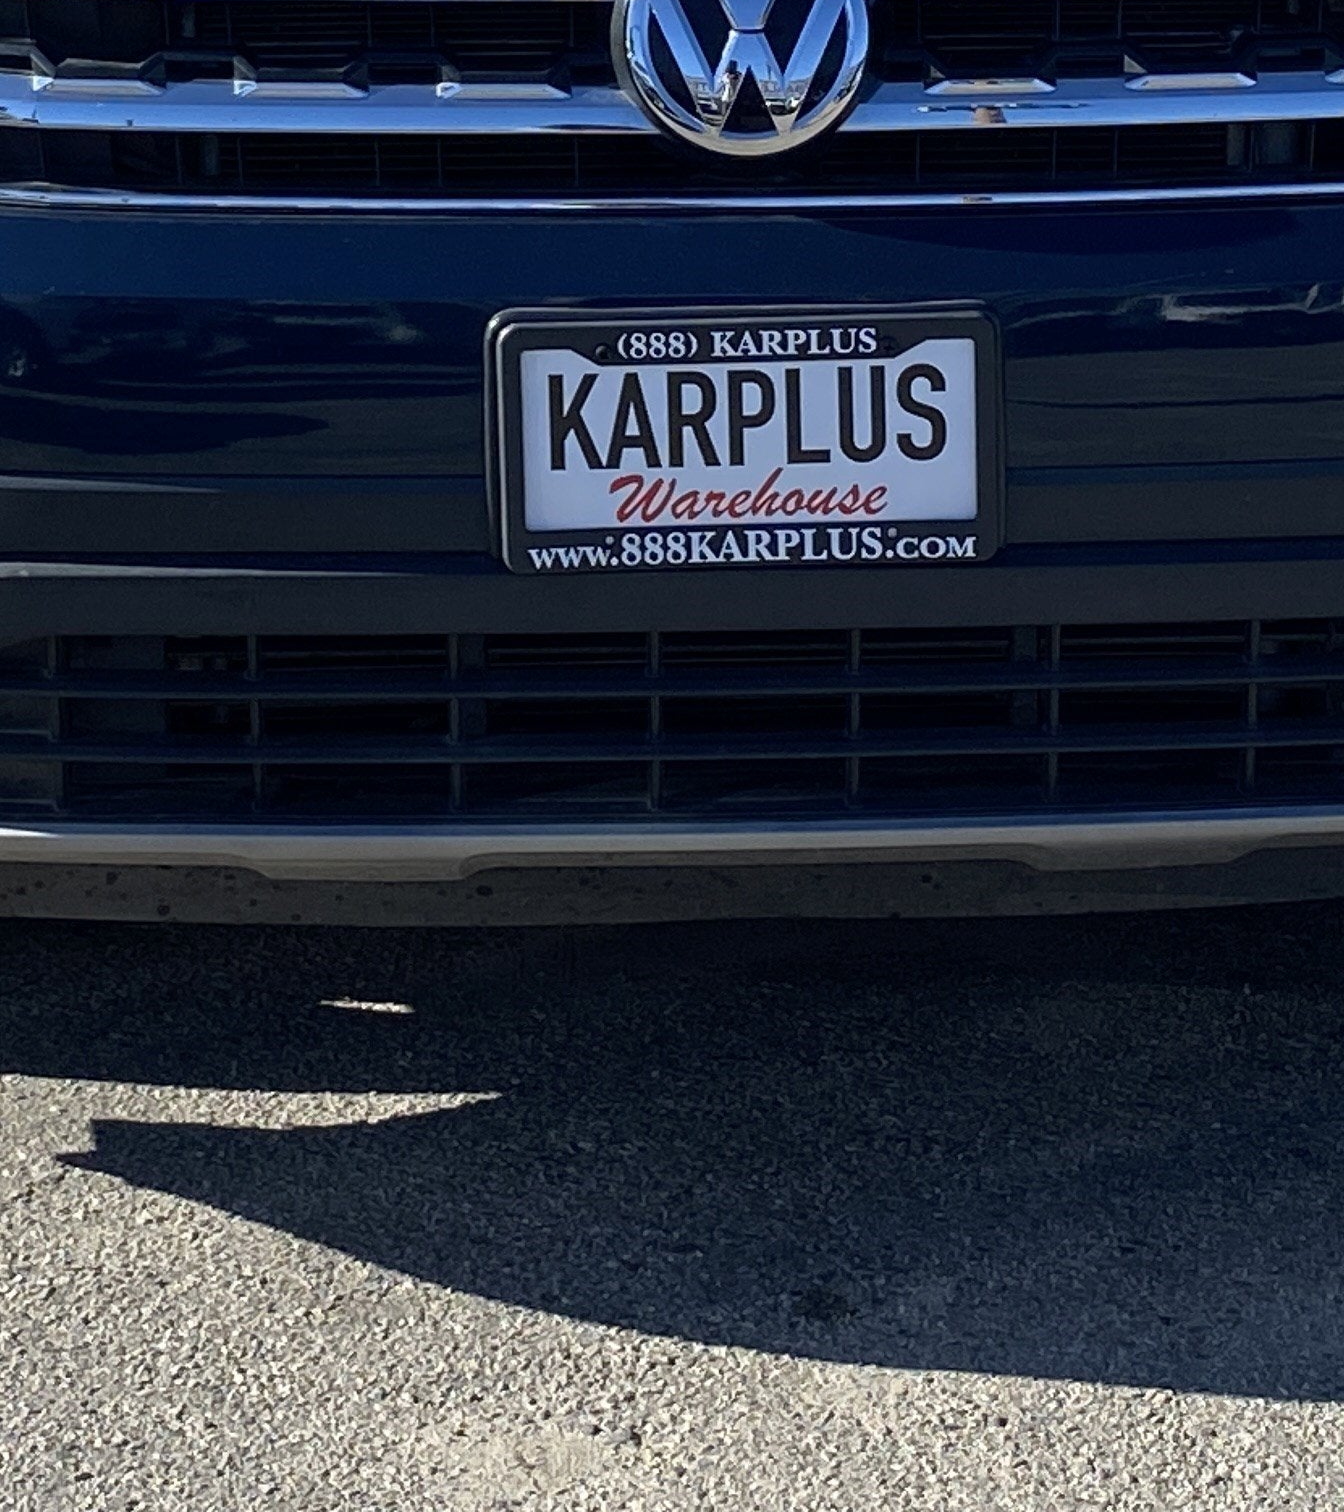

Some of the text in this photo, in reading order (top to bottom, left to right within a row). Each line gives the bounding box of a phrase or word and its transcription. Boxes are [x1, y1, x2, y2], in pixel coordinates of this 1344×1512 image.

[617, 327, 877, 359] (888) KARPLUS
[548, 363, 947, 471] KARPLUS
[609, 467, 888, 523] Warehouse
